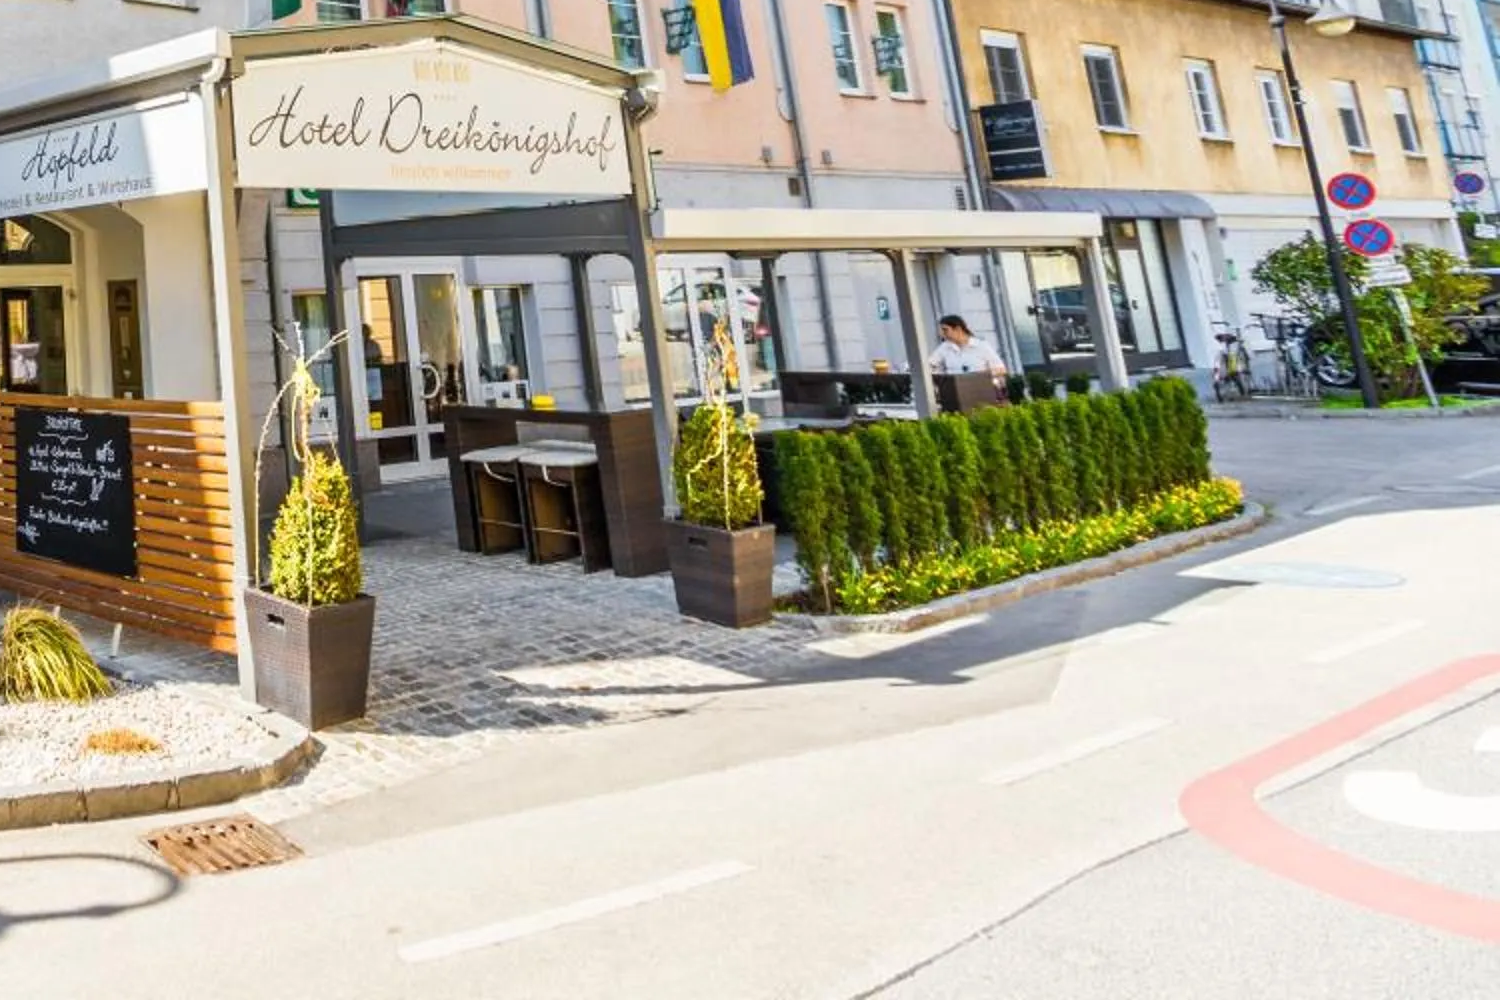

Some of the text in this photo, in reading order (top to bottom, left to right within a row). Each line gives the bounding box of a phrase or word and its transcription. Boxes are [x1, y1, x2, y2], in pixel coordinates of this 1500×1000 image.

[22, 121, 119, 187] Hopfeld
[249, 85, 616, 175] Hotel Dreikönigshof
